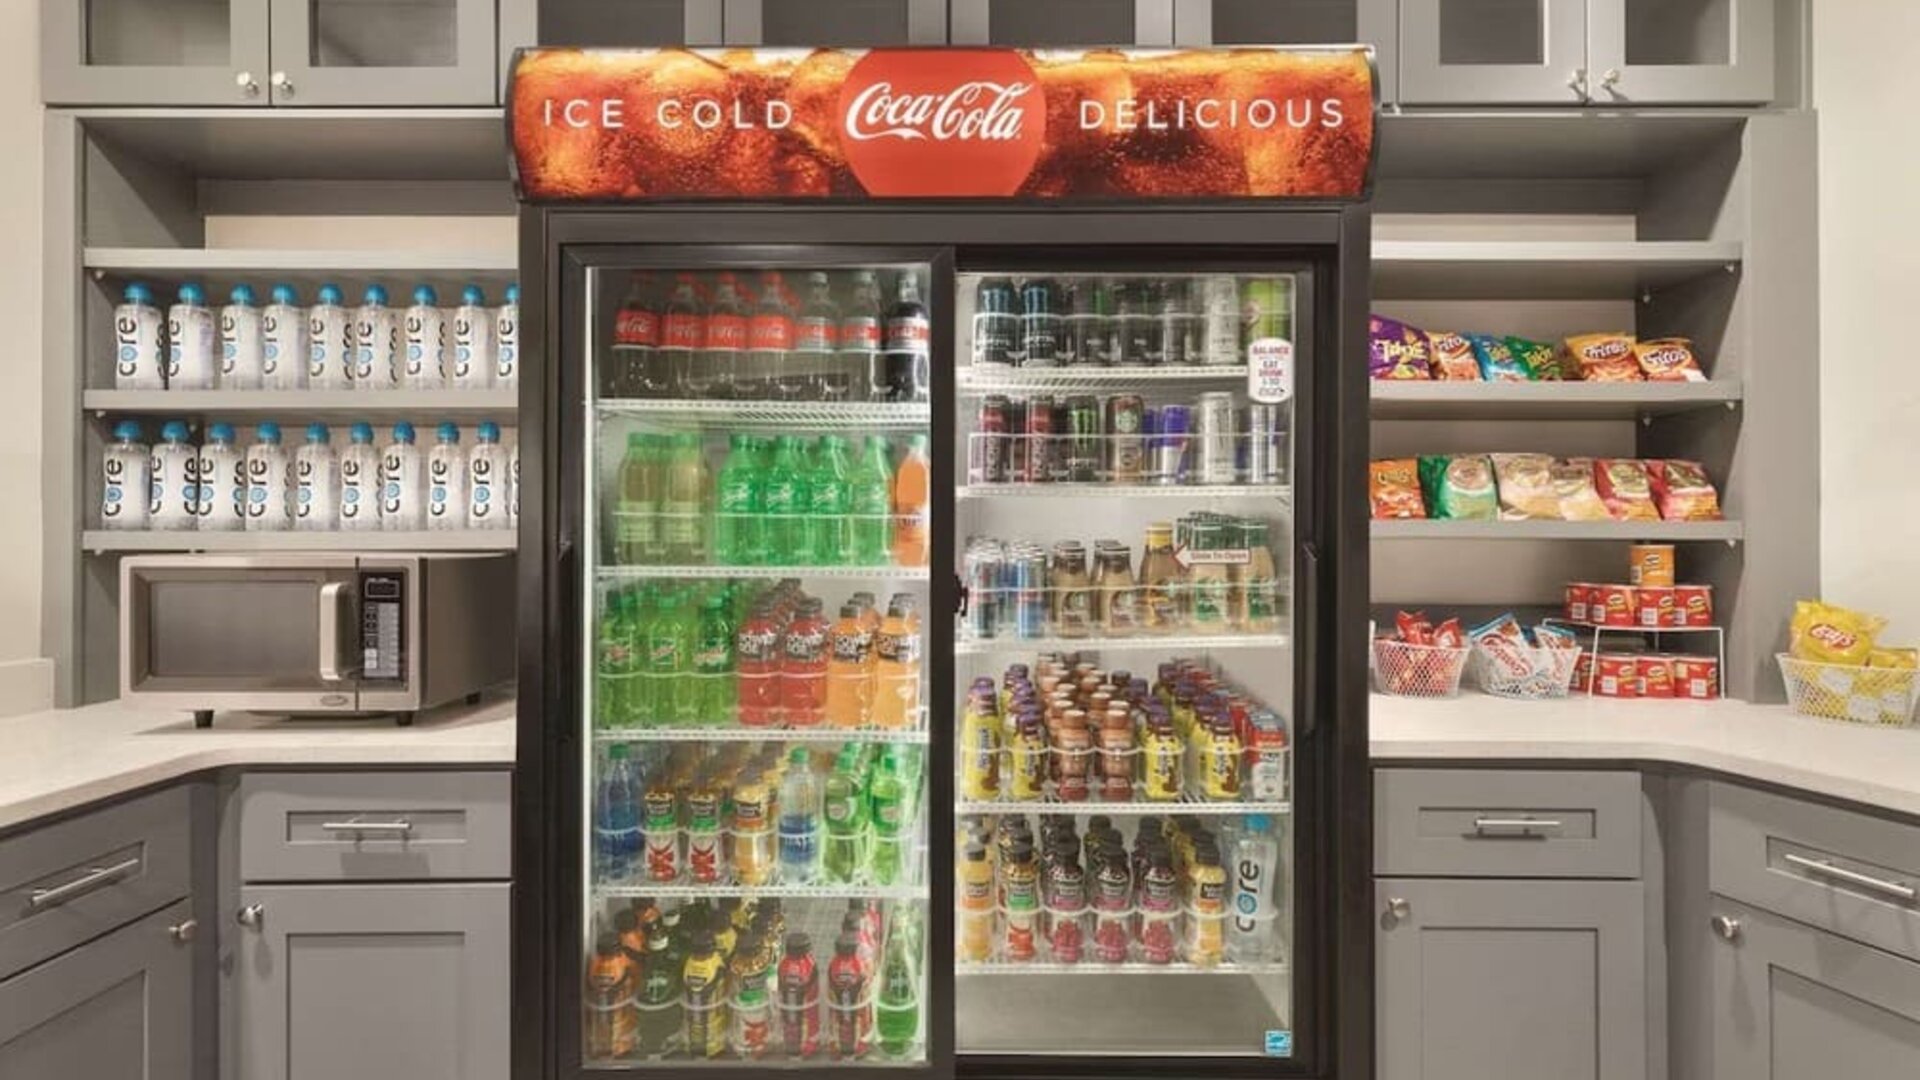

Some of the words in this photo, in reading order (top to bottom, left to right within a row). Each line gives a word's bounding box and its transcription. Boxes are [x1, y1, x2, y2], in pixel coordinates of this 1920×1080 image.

[543, 99, 625, 129] ICE
[656, 98, 793, 130] COLD
[845, 81, 1032, 141] Coca-Cola
[1080, 98, 1344, 130] DELICIOUS
[118, 316, 138, 378] core
[263, 314, 279, 375] core
[356, 320, 373, 379] core
[406, 315, 423, 376] core
[455, 318, 470, 378] core
[498, 318, 514, 378] core
[1252, 345, 1290, 355] BALANCE
[104, 457, 123, 518] core
[248, 457, 267, 518] core
[297, 458, 313, 518] core
[342, 458, 360, 518] core
[385, 453, 400, 514] core
[430, 457, 447, 517] core
[472, 457, 490, 518] core
[1236, 859, 1260, 932] core
